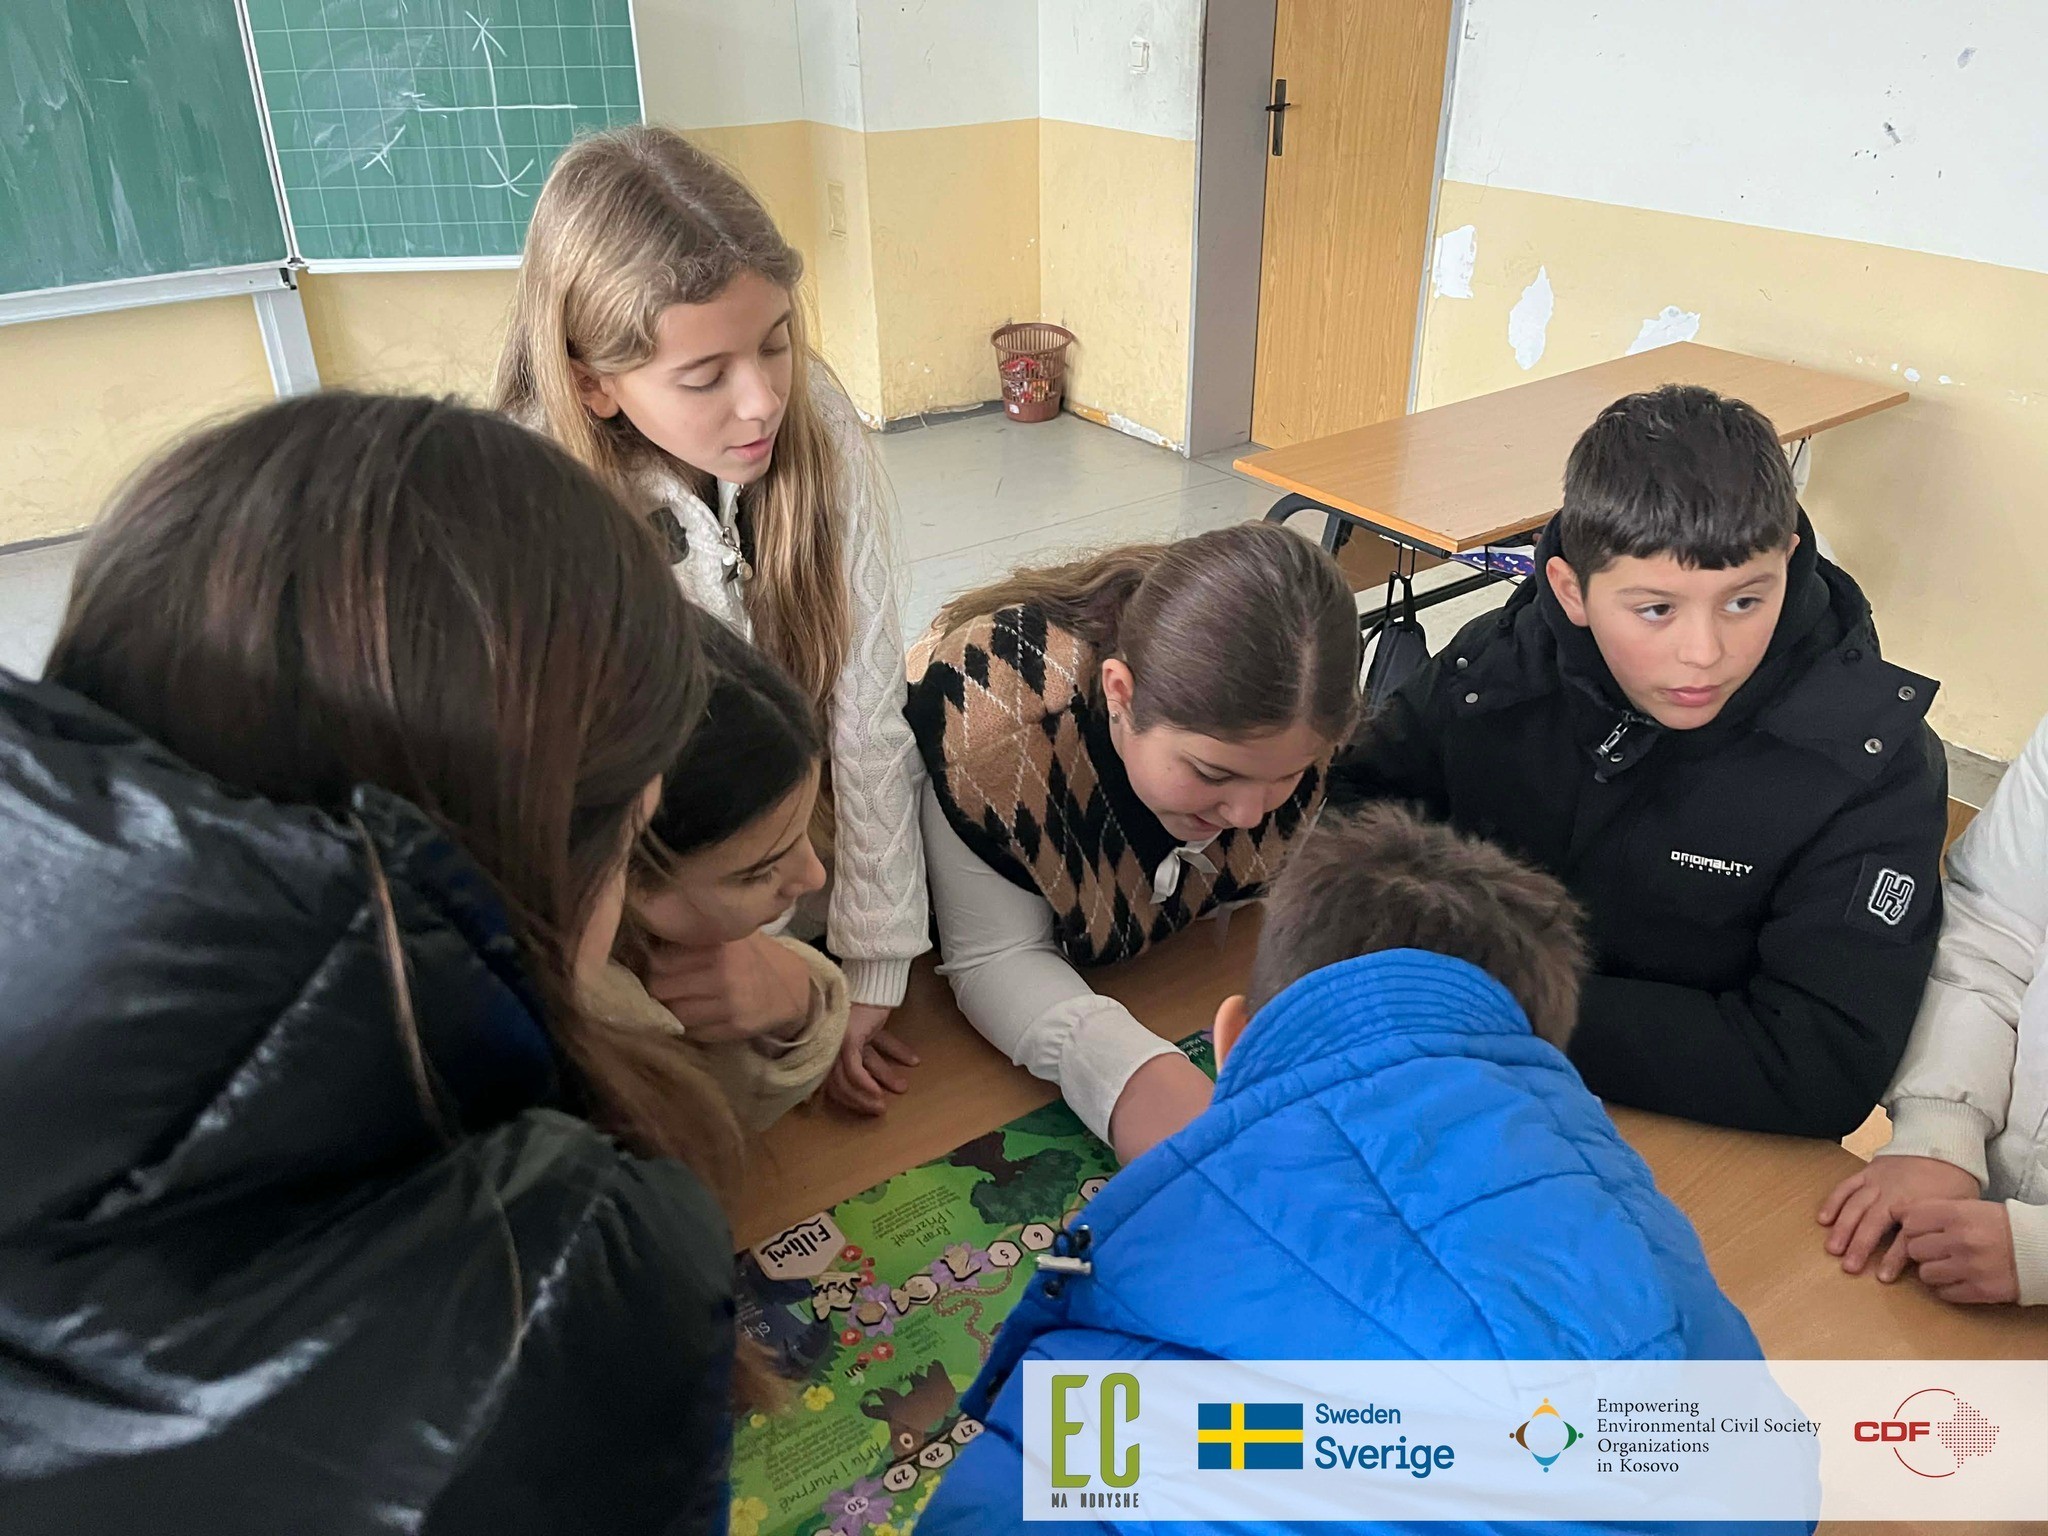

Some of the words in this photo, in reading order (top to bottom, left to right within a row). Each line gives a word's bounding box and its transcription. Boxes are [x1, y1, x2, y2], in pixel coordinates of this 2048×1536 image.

[767, 1224, 832, 1268] Fillimi
[1000, 1248, 1010, 1259] 5
[960, 1422, 978, 1439] 27
[925, 1447, 944, 1463] 28
[892, 1469, 910, 1485] 29
[847, 1497, 867, 1513] 30
